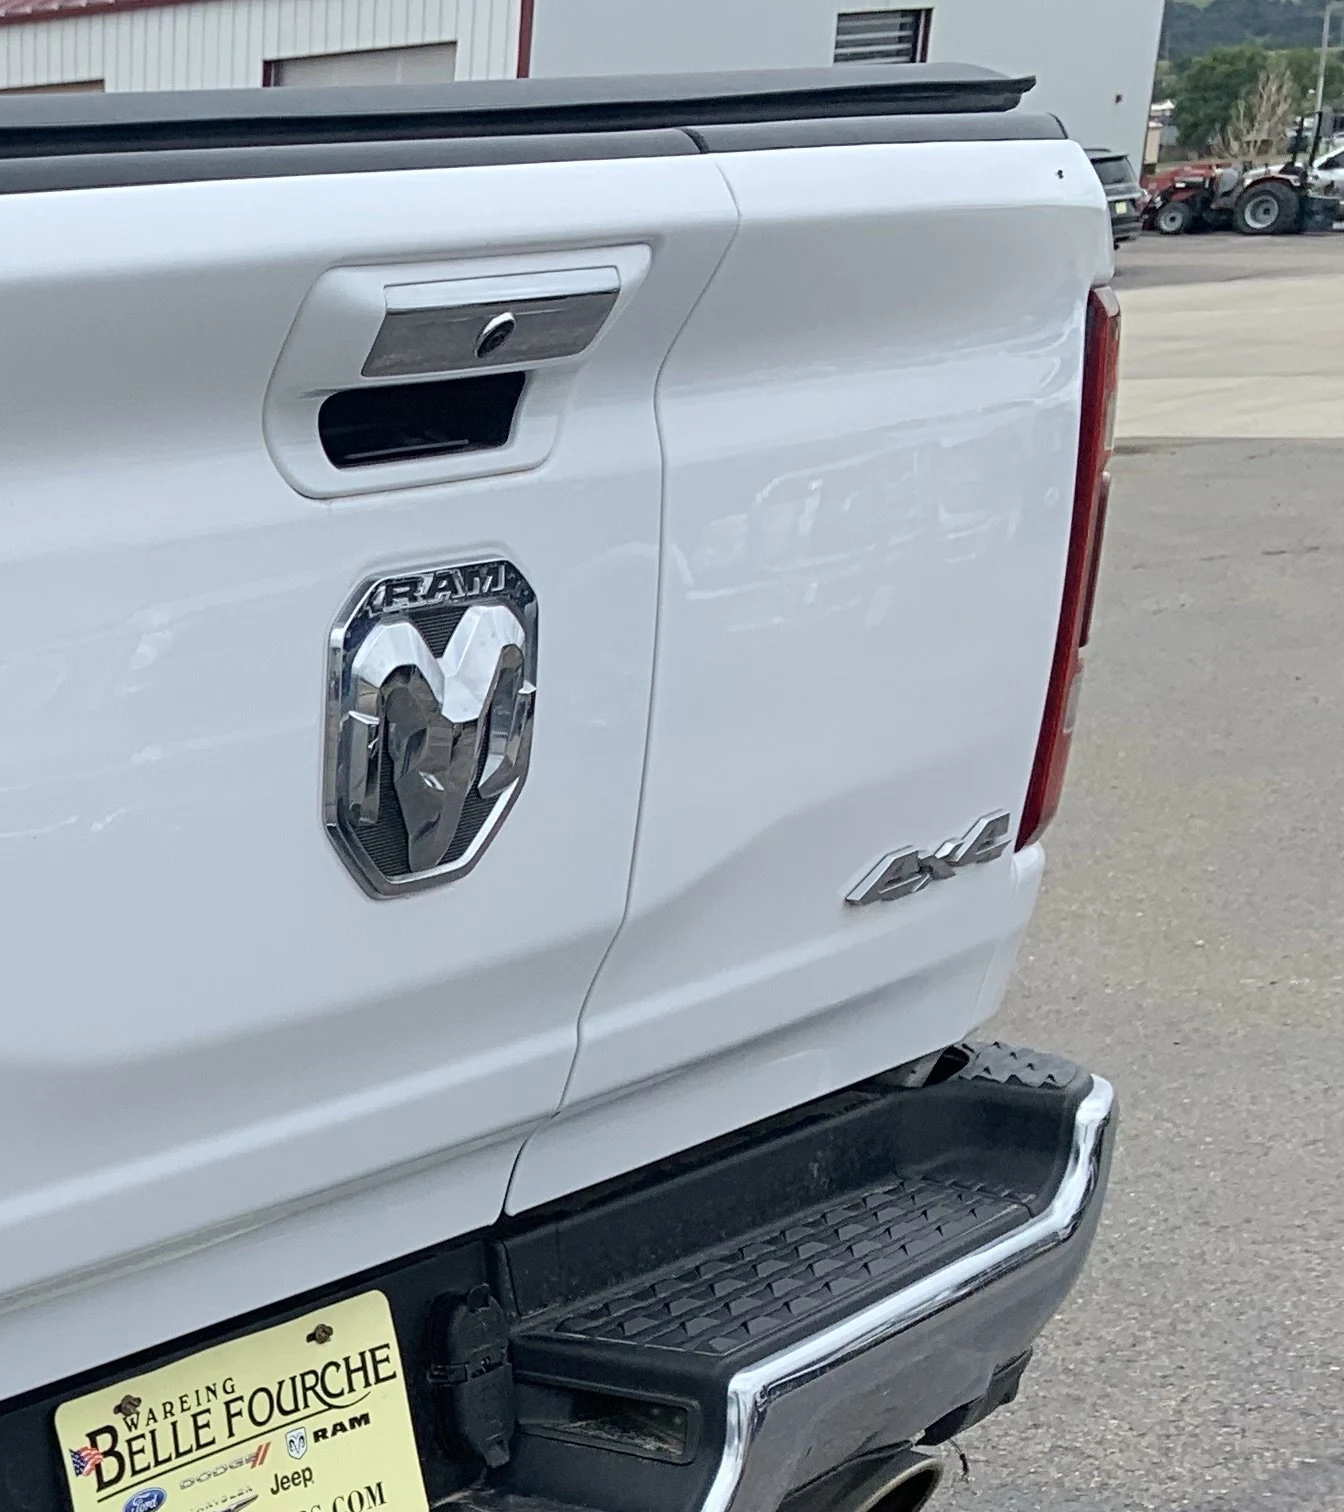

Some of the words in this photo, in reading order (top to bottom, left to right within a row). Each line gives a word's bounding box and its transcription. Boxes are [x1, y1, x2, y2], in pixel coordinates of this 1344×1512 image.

[382, 564, 506, 612] RAM
[85, 1404, 216, 1493] BELLE
[225, 1343, 398, 1438] FOURCHE
[122, 1377, 237, 1432] WAREING
[313, 1412, 371, 1443] RAM
[179, 1453, 258, 1490] DODGE
[269, 1465, 314, 1496] Jeep
